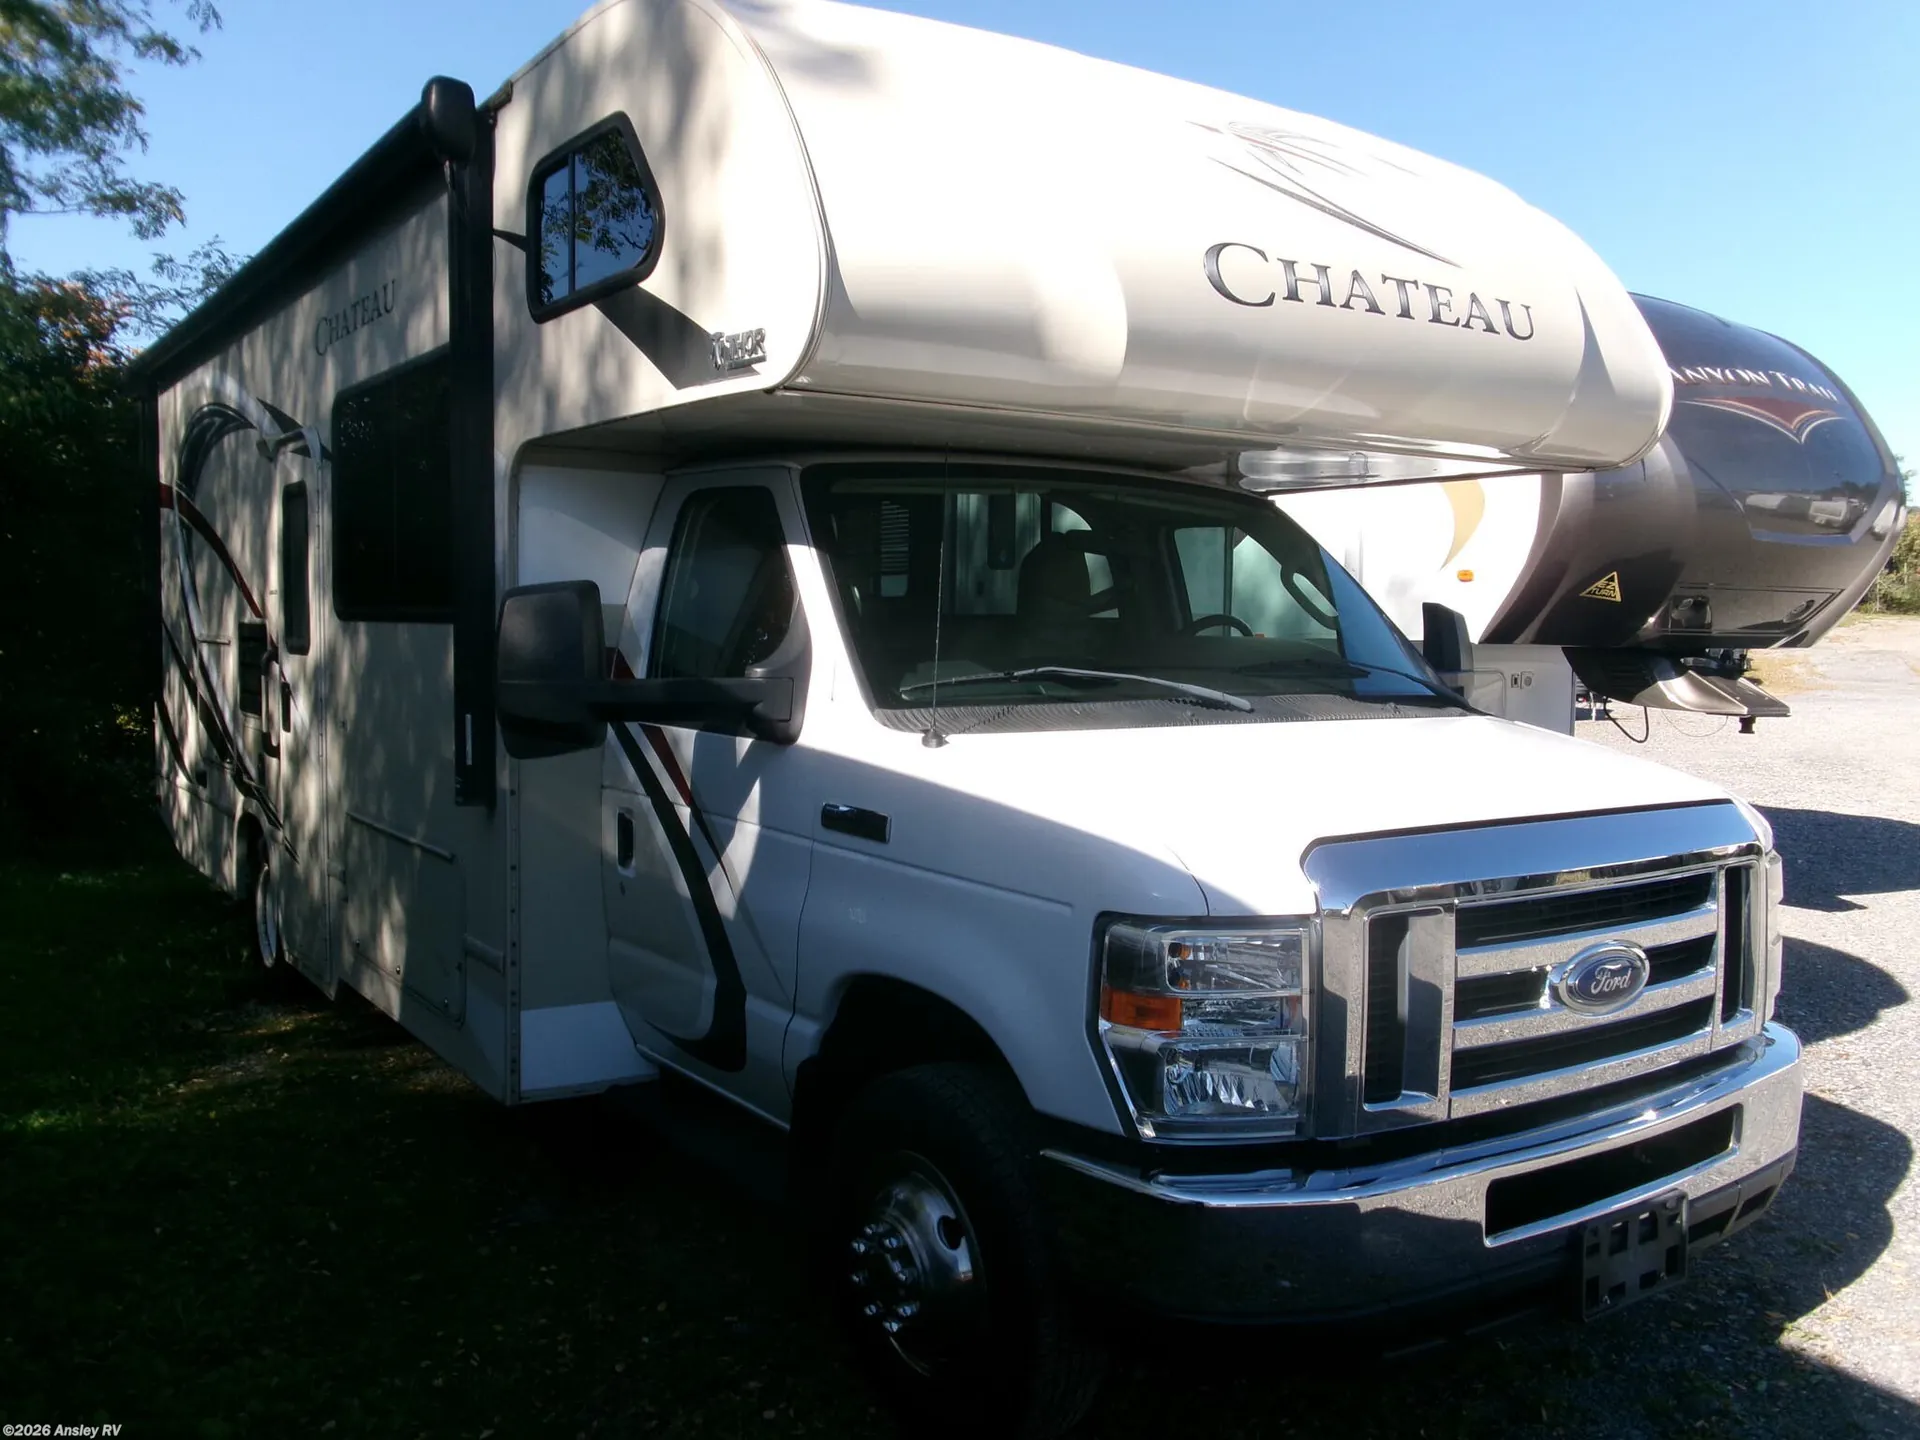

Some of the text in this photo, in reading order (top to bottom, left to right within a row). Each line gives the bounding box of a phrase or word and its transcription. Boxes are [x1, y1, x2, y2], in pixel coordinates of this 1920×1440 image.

[1203, 242, 1535, 341] CHATEAU
[315, 278, 395, 356] CHATEAU
[1668, 365, 1773, 387] ANYON
[1590, 587, 1617, 598] TURN
[1597, 580, 1616, 590] EZ
[1590, 963, 1632, 995] Ford
